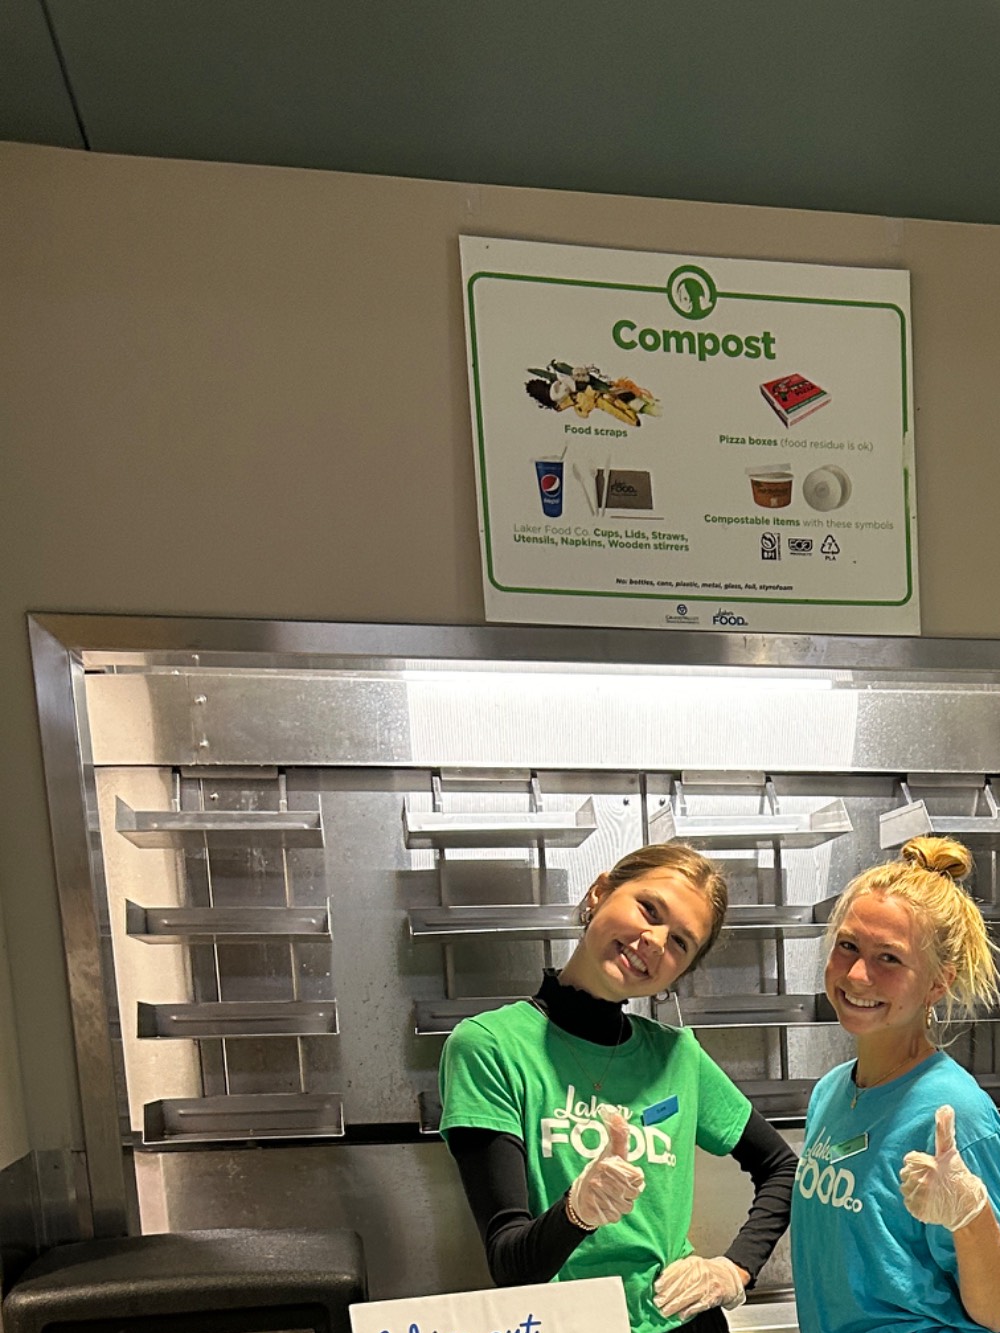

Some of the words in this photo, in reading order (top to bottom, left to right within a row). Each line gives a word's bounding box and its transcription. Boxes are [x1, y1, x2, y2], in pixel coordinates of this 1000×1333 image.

[611, 319, 776, 361] Compost
[564, 424, 592, 435] Food
[594, 428, 628, 438] scraps
[719, 435, 746, 445] Pizza
[748, 436, 778, 447] boxes
[780, 437, 807, 448] (food
[810, 439, 844, 450] residue
[857, 442, 874, 452] ok)
[704, 514, 770, 526] Compostable
[802, 518, 824, 528] with
[826, 519, 852, 529] these
[854, 520, 894, 531] symbols
[513, 524, 541, 534] Laker
[545, 525, 571, 536] Food
[593, 528, 622, 539] Cups,
[625, 529, 649, 541] Lids,
[651, 531, 689, 542] Straws,
[513, 534, 558, 546] Utensils,
[561, 536, 605, 549] Napkins,
[608, 540, 650, 550] Wooden
[653, 543, 690, 551] stirrers
[713, 615, 744, 626] FOOD
[553, 1084, 633, 1124] Lakr
